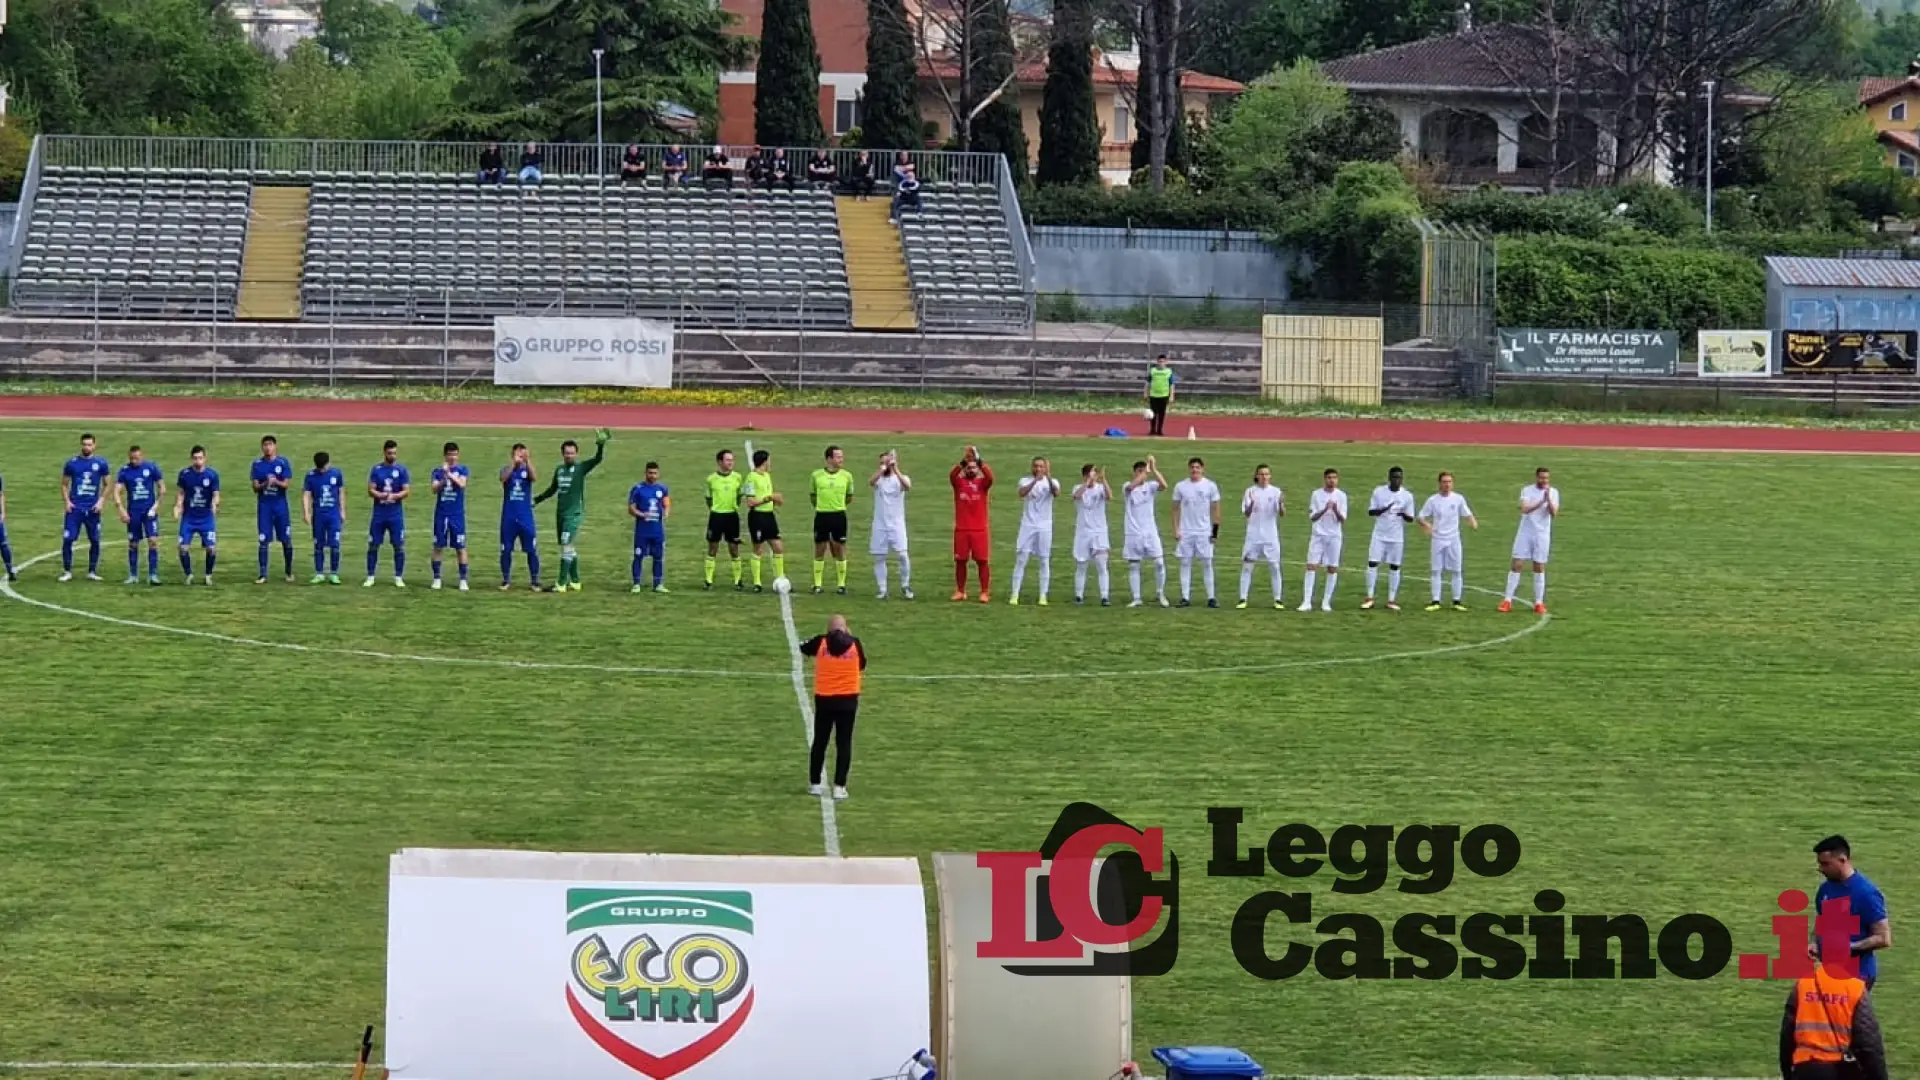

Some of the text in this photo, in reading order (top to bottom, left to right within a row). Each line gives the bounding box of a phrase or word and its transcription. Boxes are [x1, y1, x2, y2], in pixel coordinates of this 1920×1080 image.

[1527, 332, 1664, 346] IL FARMACISTA
[525, 338, 666, 355] GRUPPO ROSSI
[610, 906, 708, 919] GRUPPO
[604, 986, 719, 1023] LIRI
[1804, 991, 1849, 1005] STAFF
